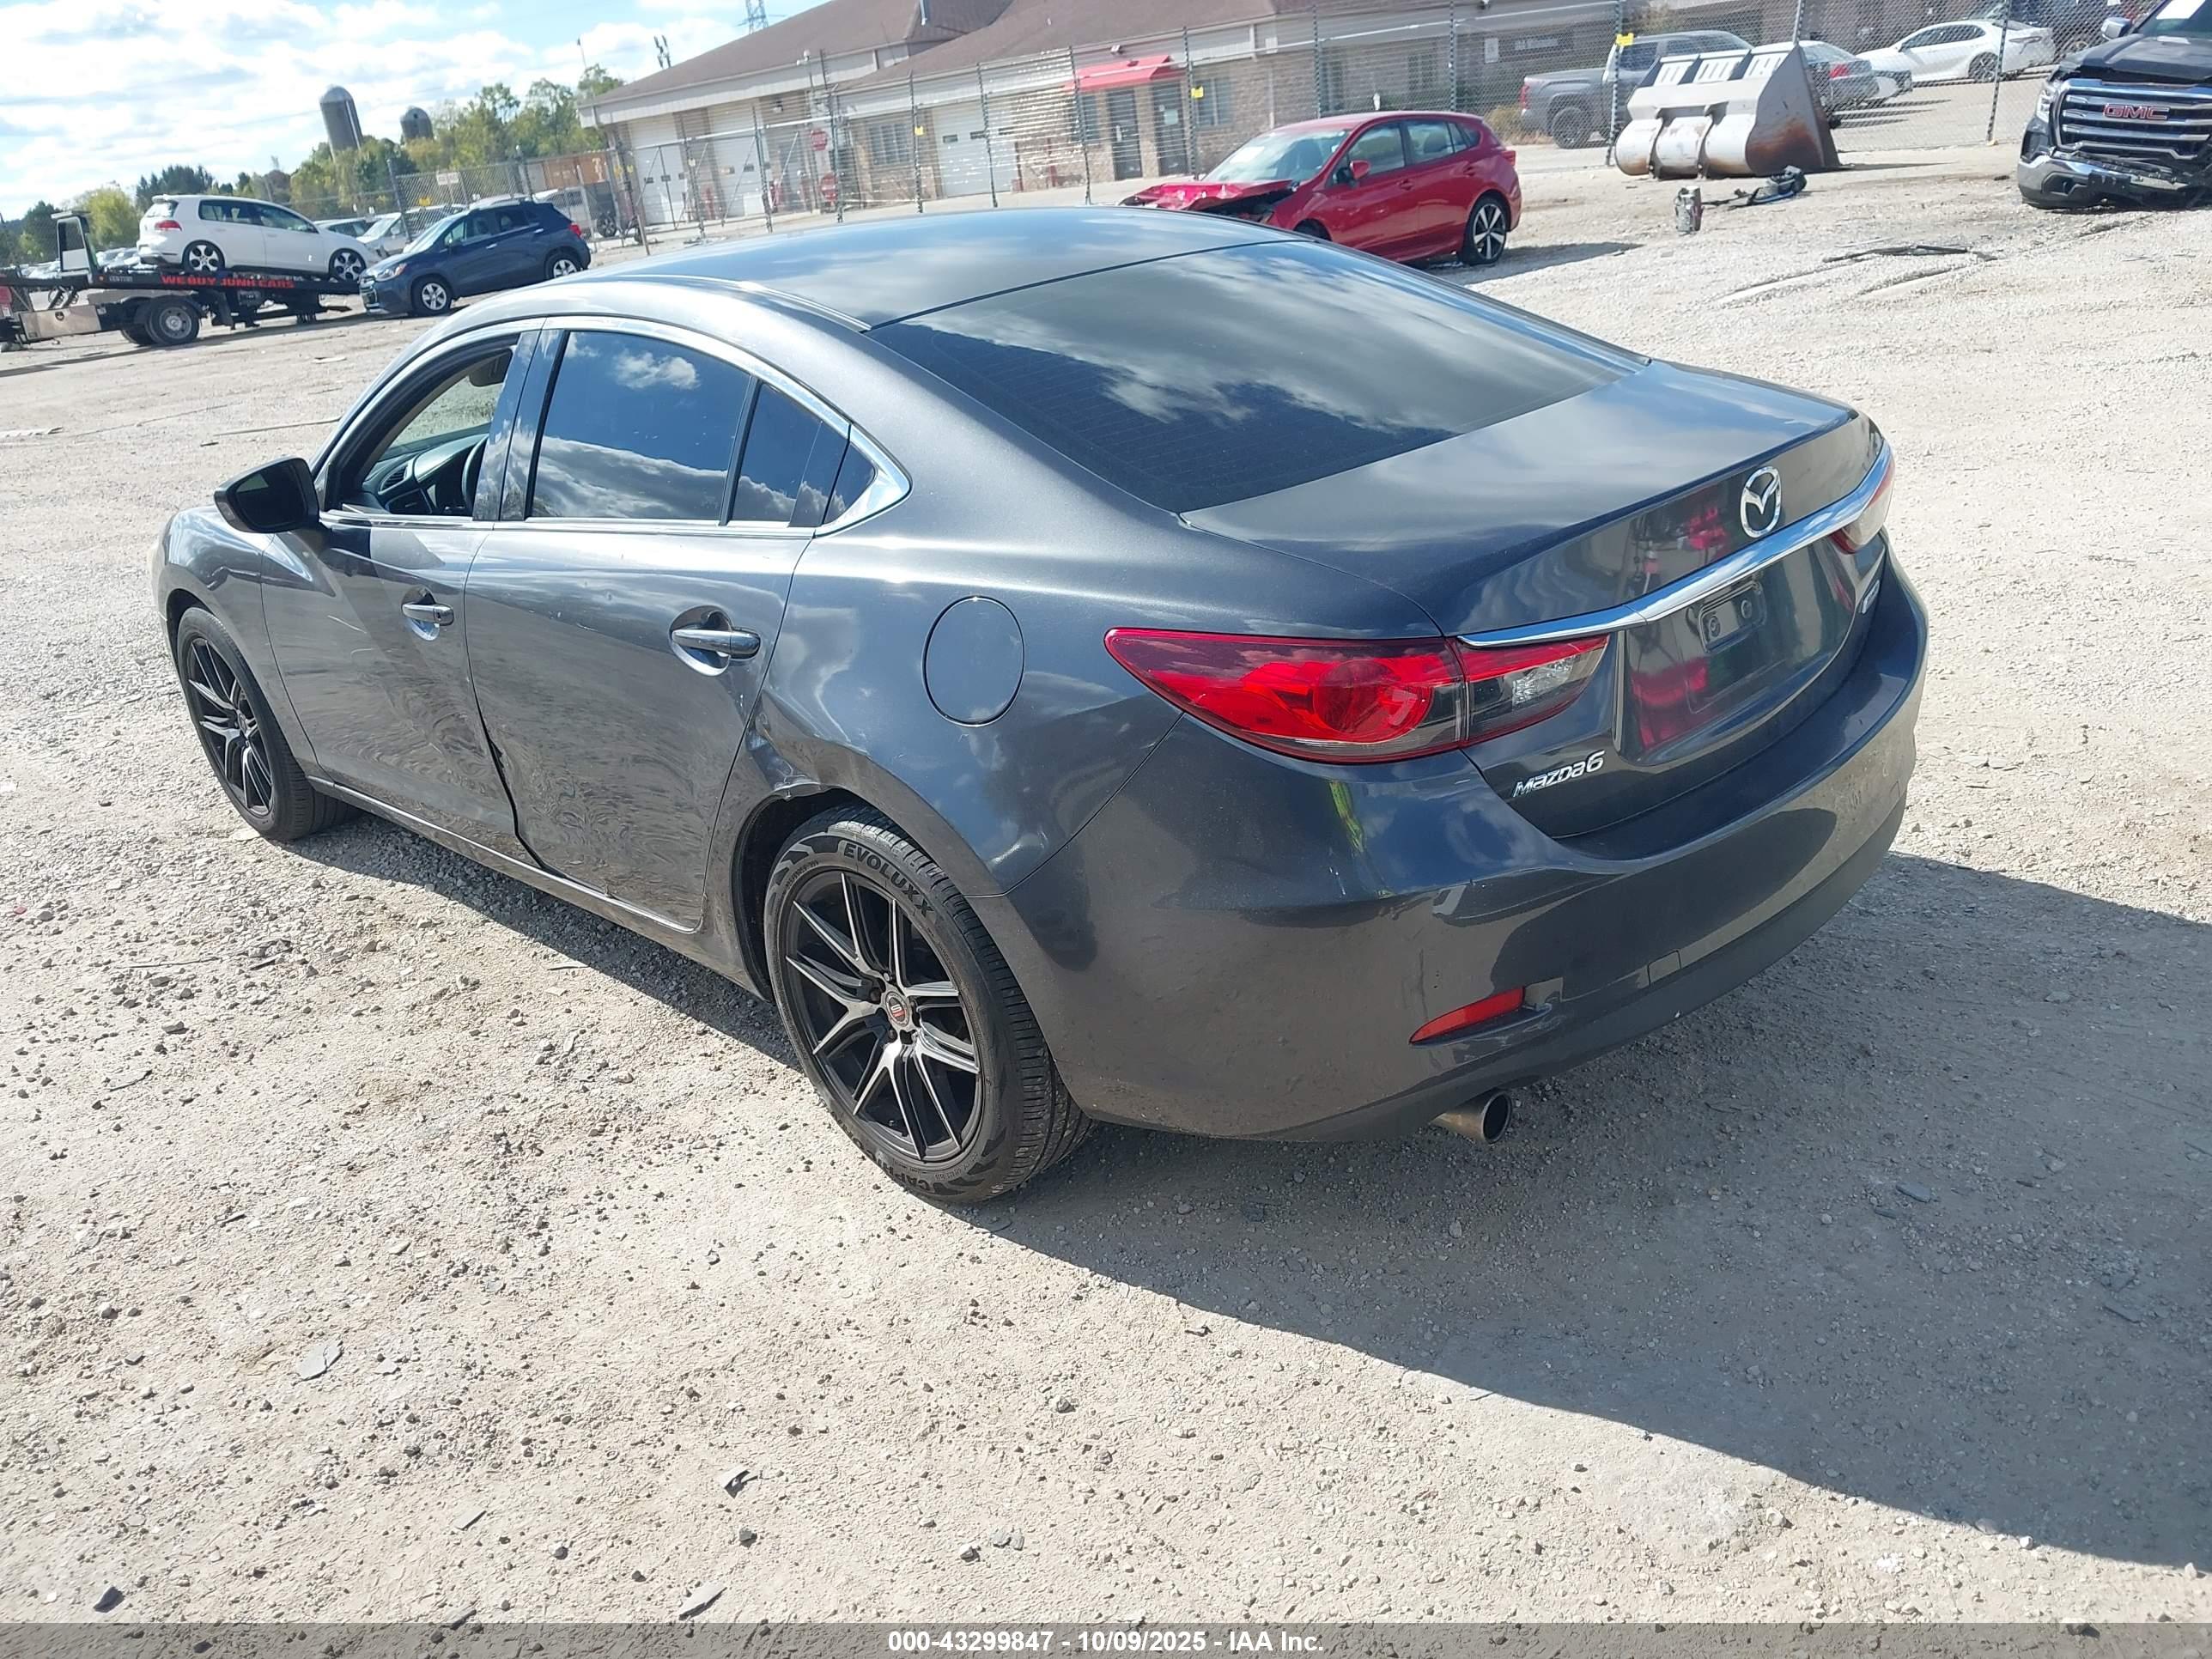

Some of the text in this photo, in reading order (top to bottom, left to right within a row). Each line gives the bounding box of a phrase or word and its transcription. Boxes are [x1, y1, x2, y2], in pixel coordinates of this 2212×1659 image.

[2104, 103, 2171, 120] GMC
[161, 275, 295, 289] WE BUY JUNK CARS
[843, 842, 934, 918] EVOLUXX
